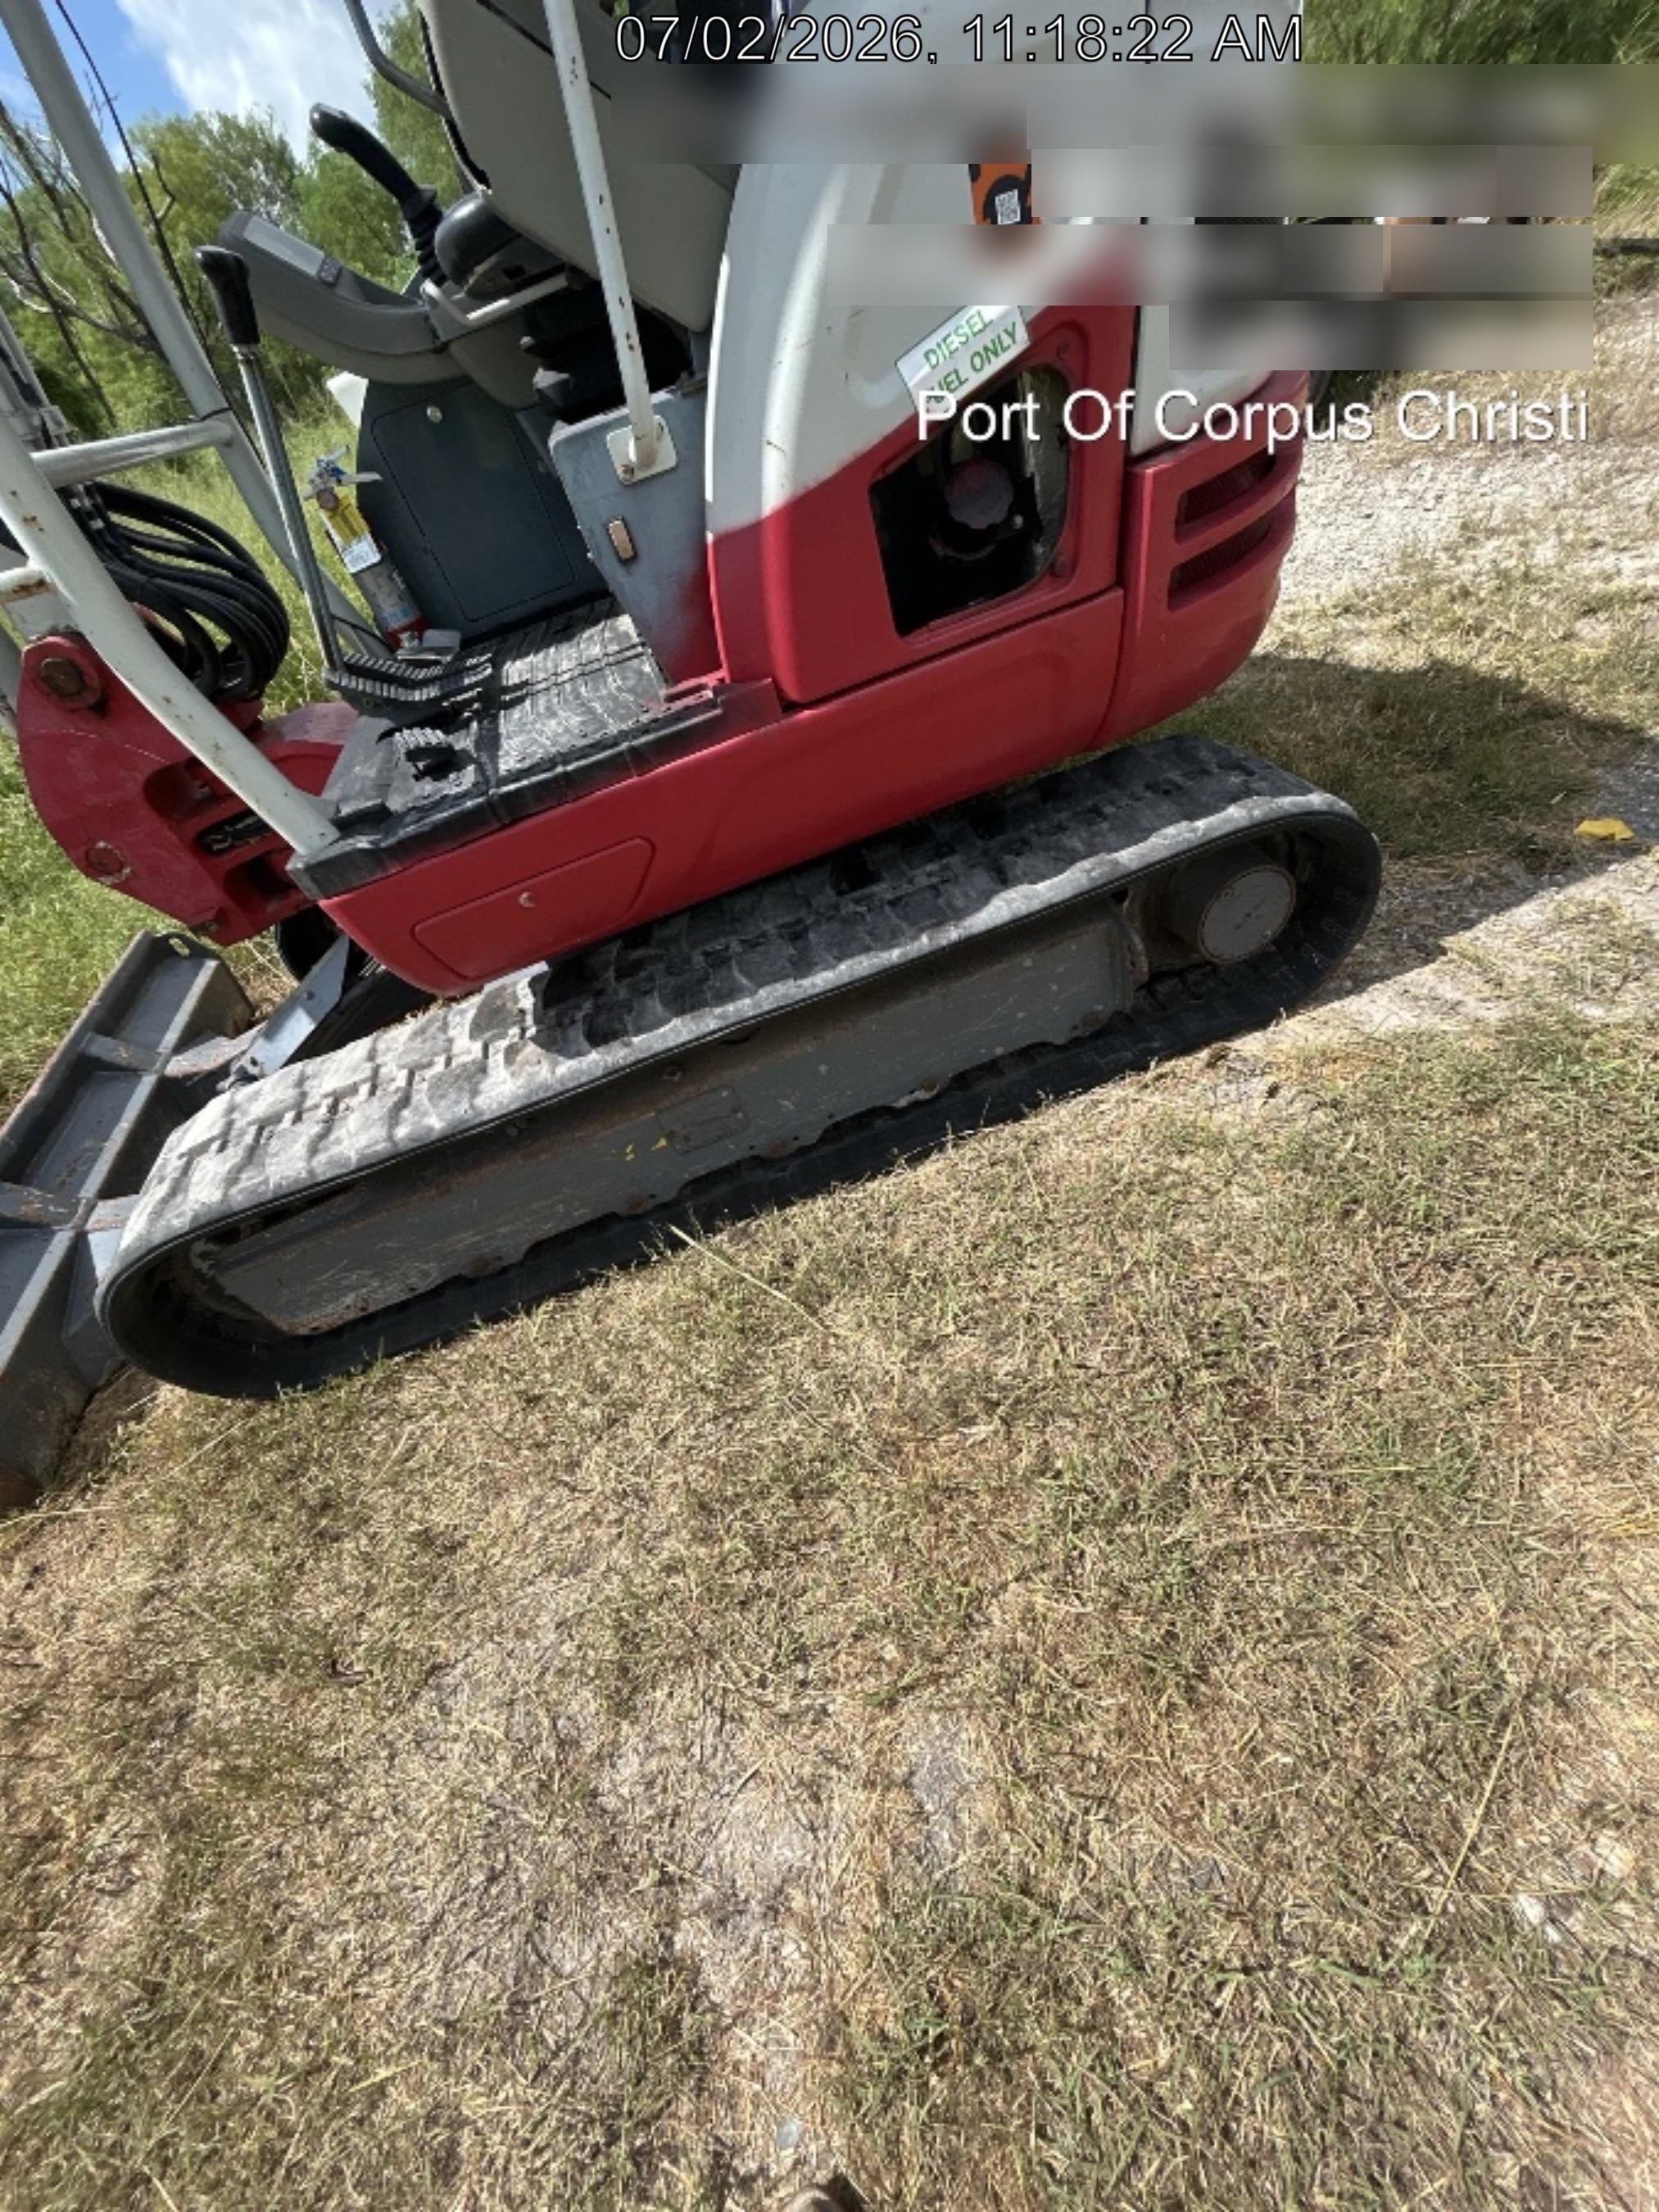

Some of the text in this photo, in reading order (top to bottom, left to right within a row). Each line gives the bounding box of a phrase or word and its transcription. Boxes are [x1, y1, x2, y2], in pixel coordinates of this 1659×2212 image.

[920, 321, 1017, 411] UEL ONLY
[923, 309, 994, 369] DIESEL
